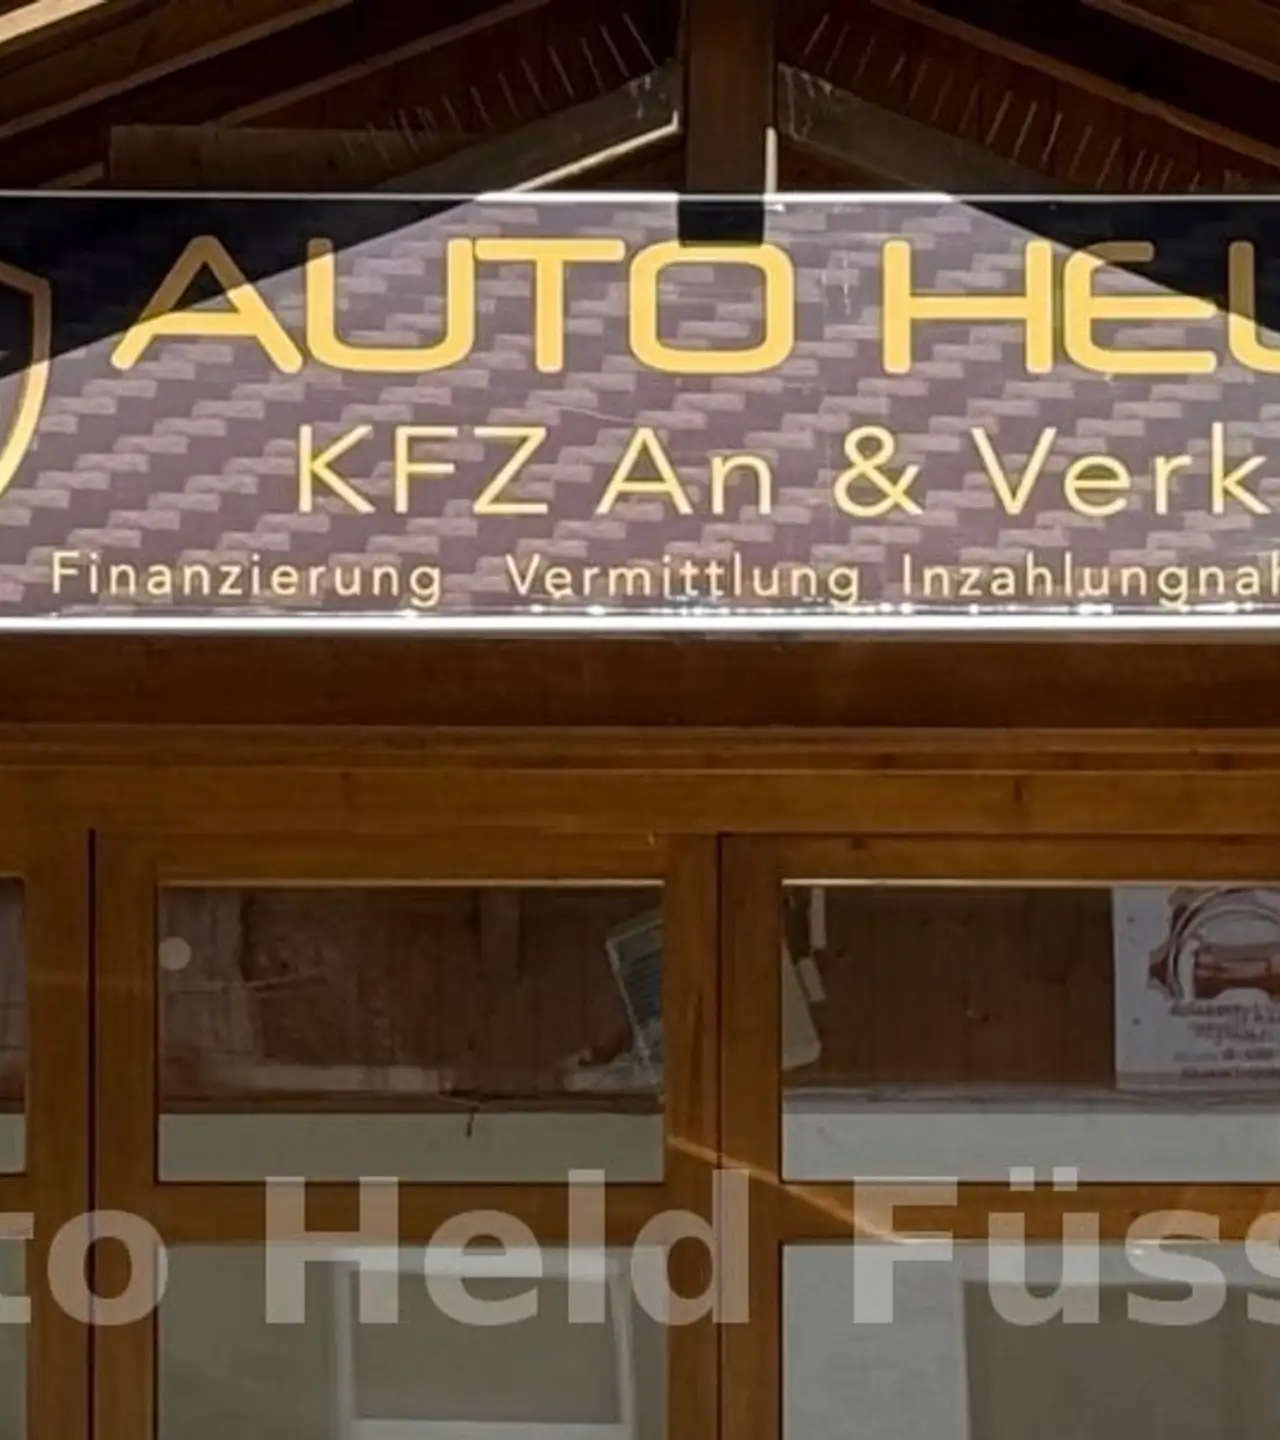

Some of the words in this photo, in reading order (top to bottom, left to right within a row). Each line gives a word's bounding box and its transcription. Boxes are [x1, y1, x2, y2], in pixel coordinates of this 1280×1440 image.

[110, 235, 794, 374] AUTO
[297, 425, 549, 516] KFZ
[596, 425, 772, 516] An
[833, 424, 923, 518] &
[51, 551, 442, 607] Finanzierung
[505, 553, 860, 607] Vermittlung
